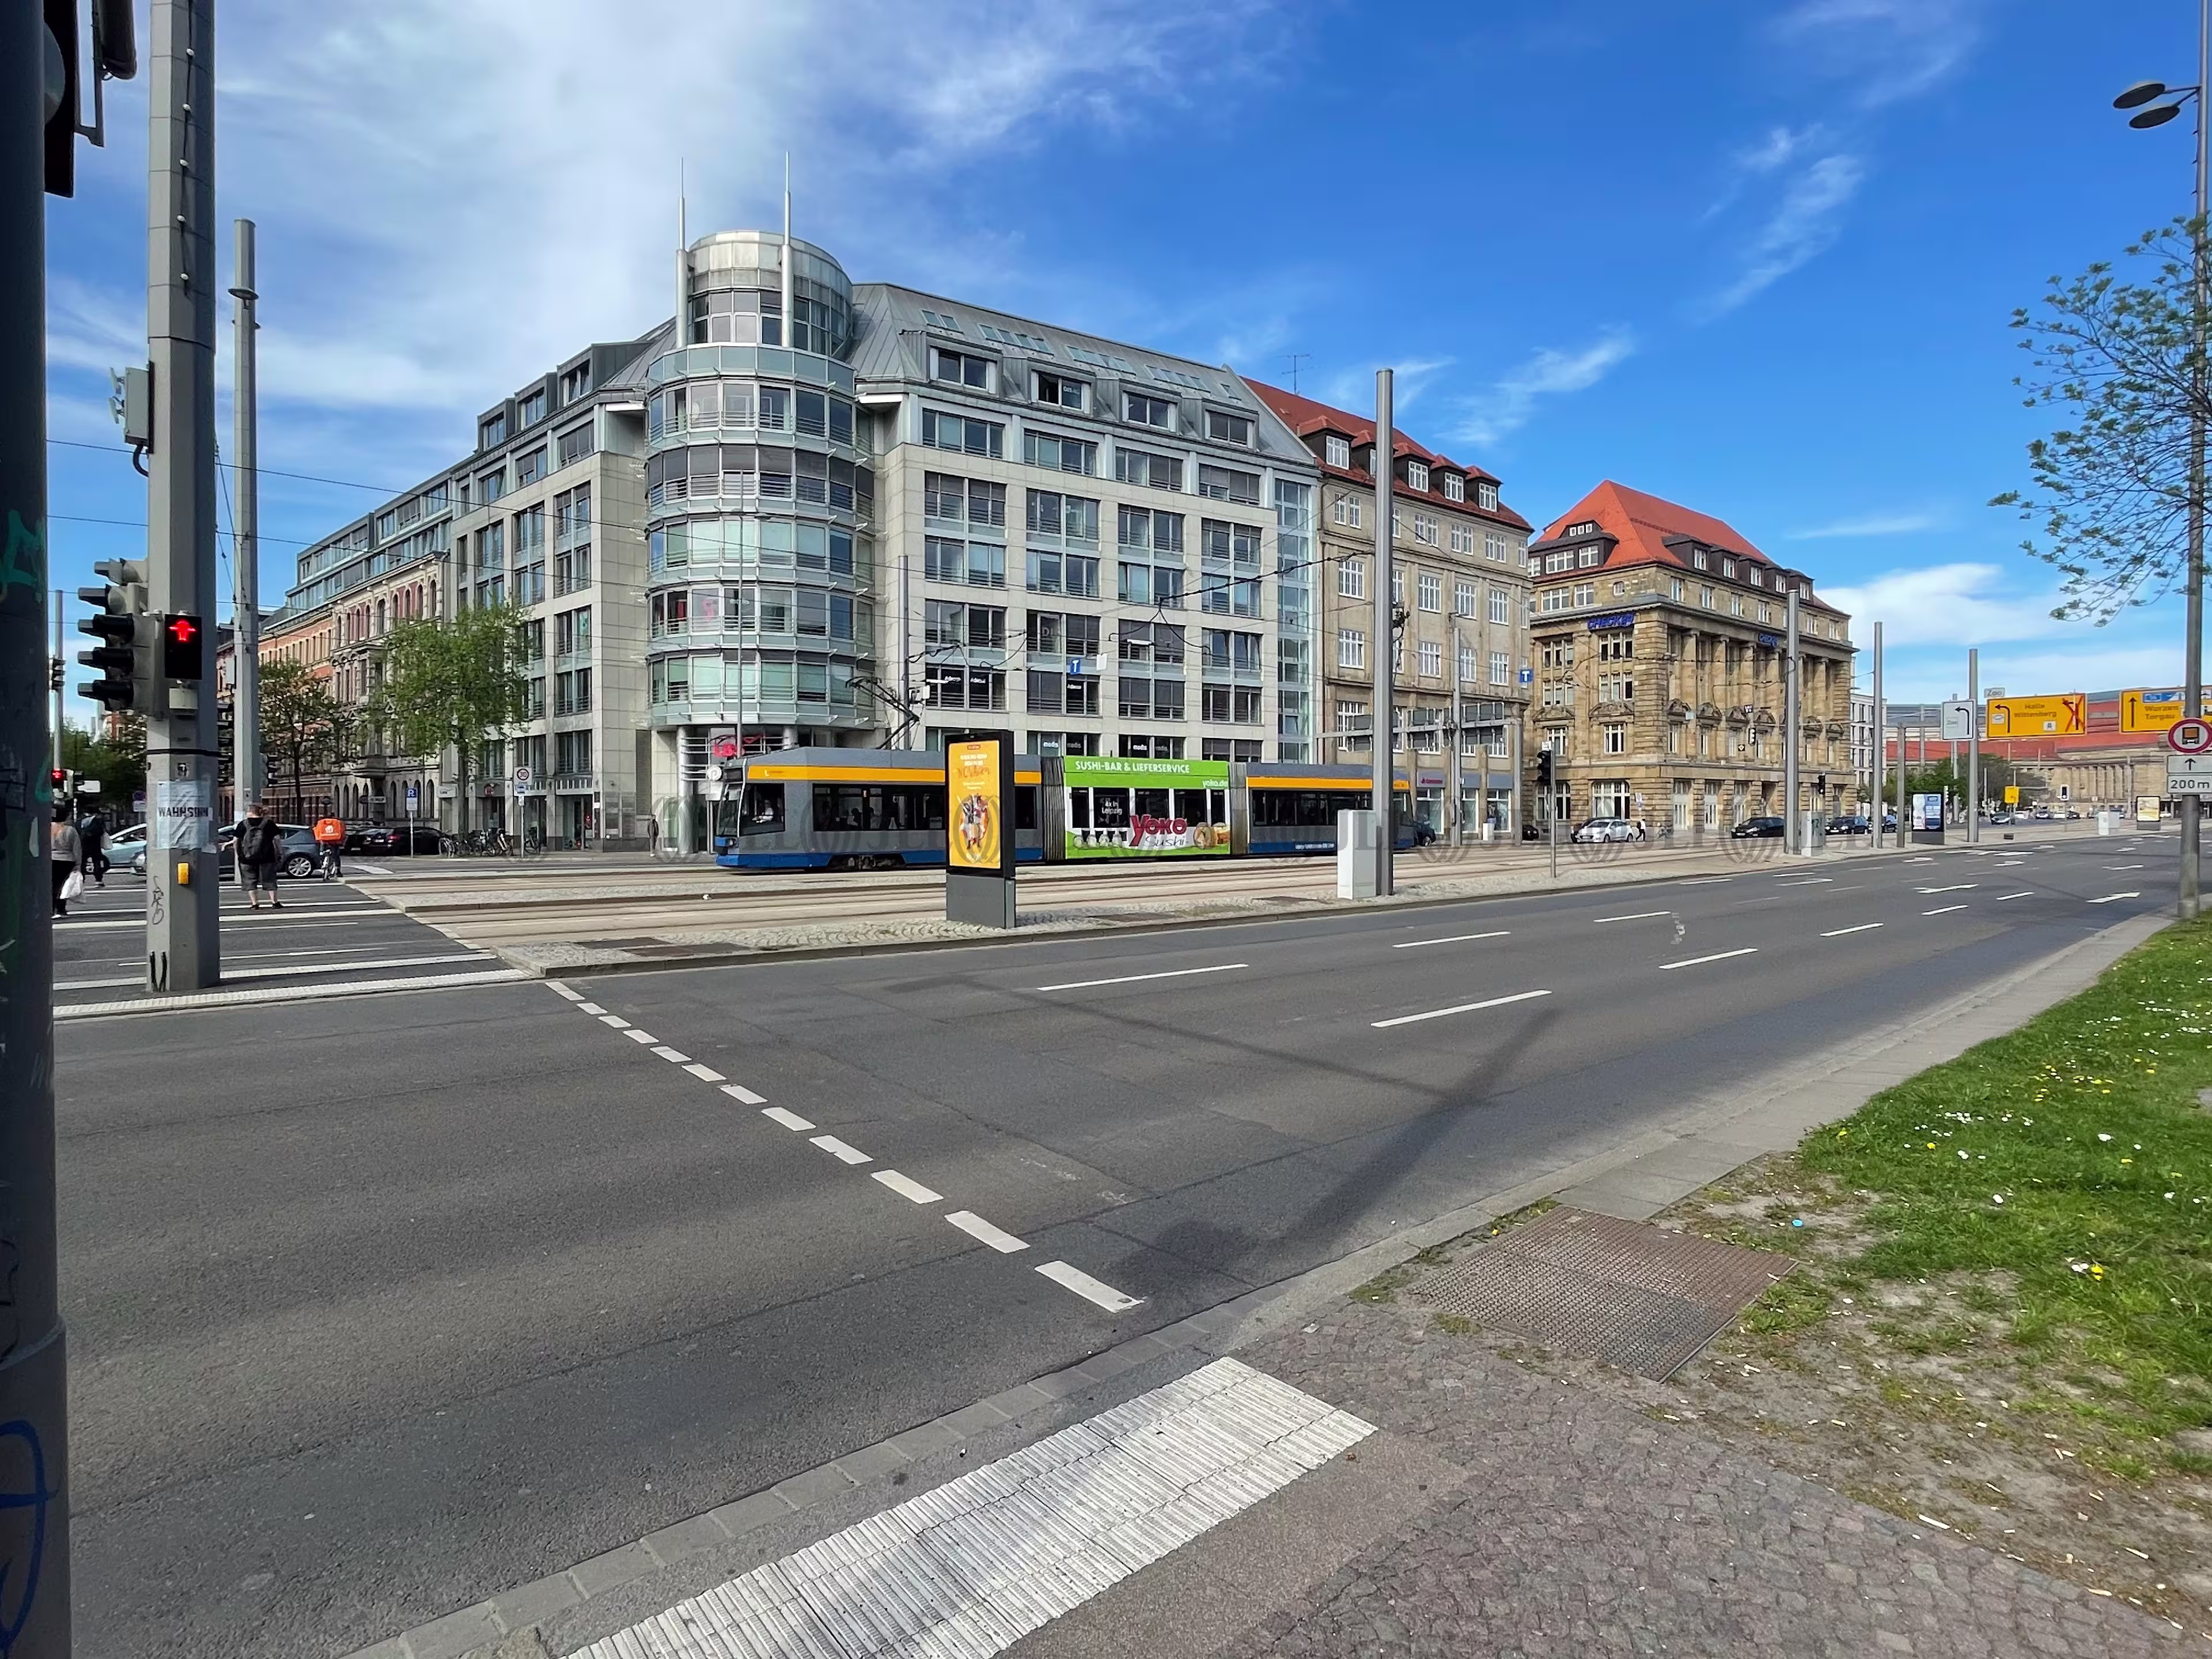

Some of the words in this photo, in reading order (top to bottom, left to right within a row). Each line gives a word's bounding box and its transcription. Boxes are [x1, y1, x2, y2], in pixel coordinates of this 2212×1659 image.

[1987, 689, 2002, 697] Zoo
[1075, 760, 1122, 771] SUSHI-BAR
[1124, 762, 1131, 771] &
[1132, 763, 1190, 774] LIEFERSERVICE
[1202, 779, 1228, 788] yoko.de
[1101, 807, 1123, 815] Leipzig
[1145, 836, 1186, 847] Sushi
